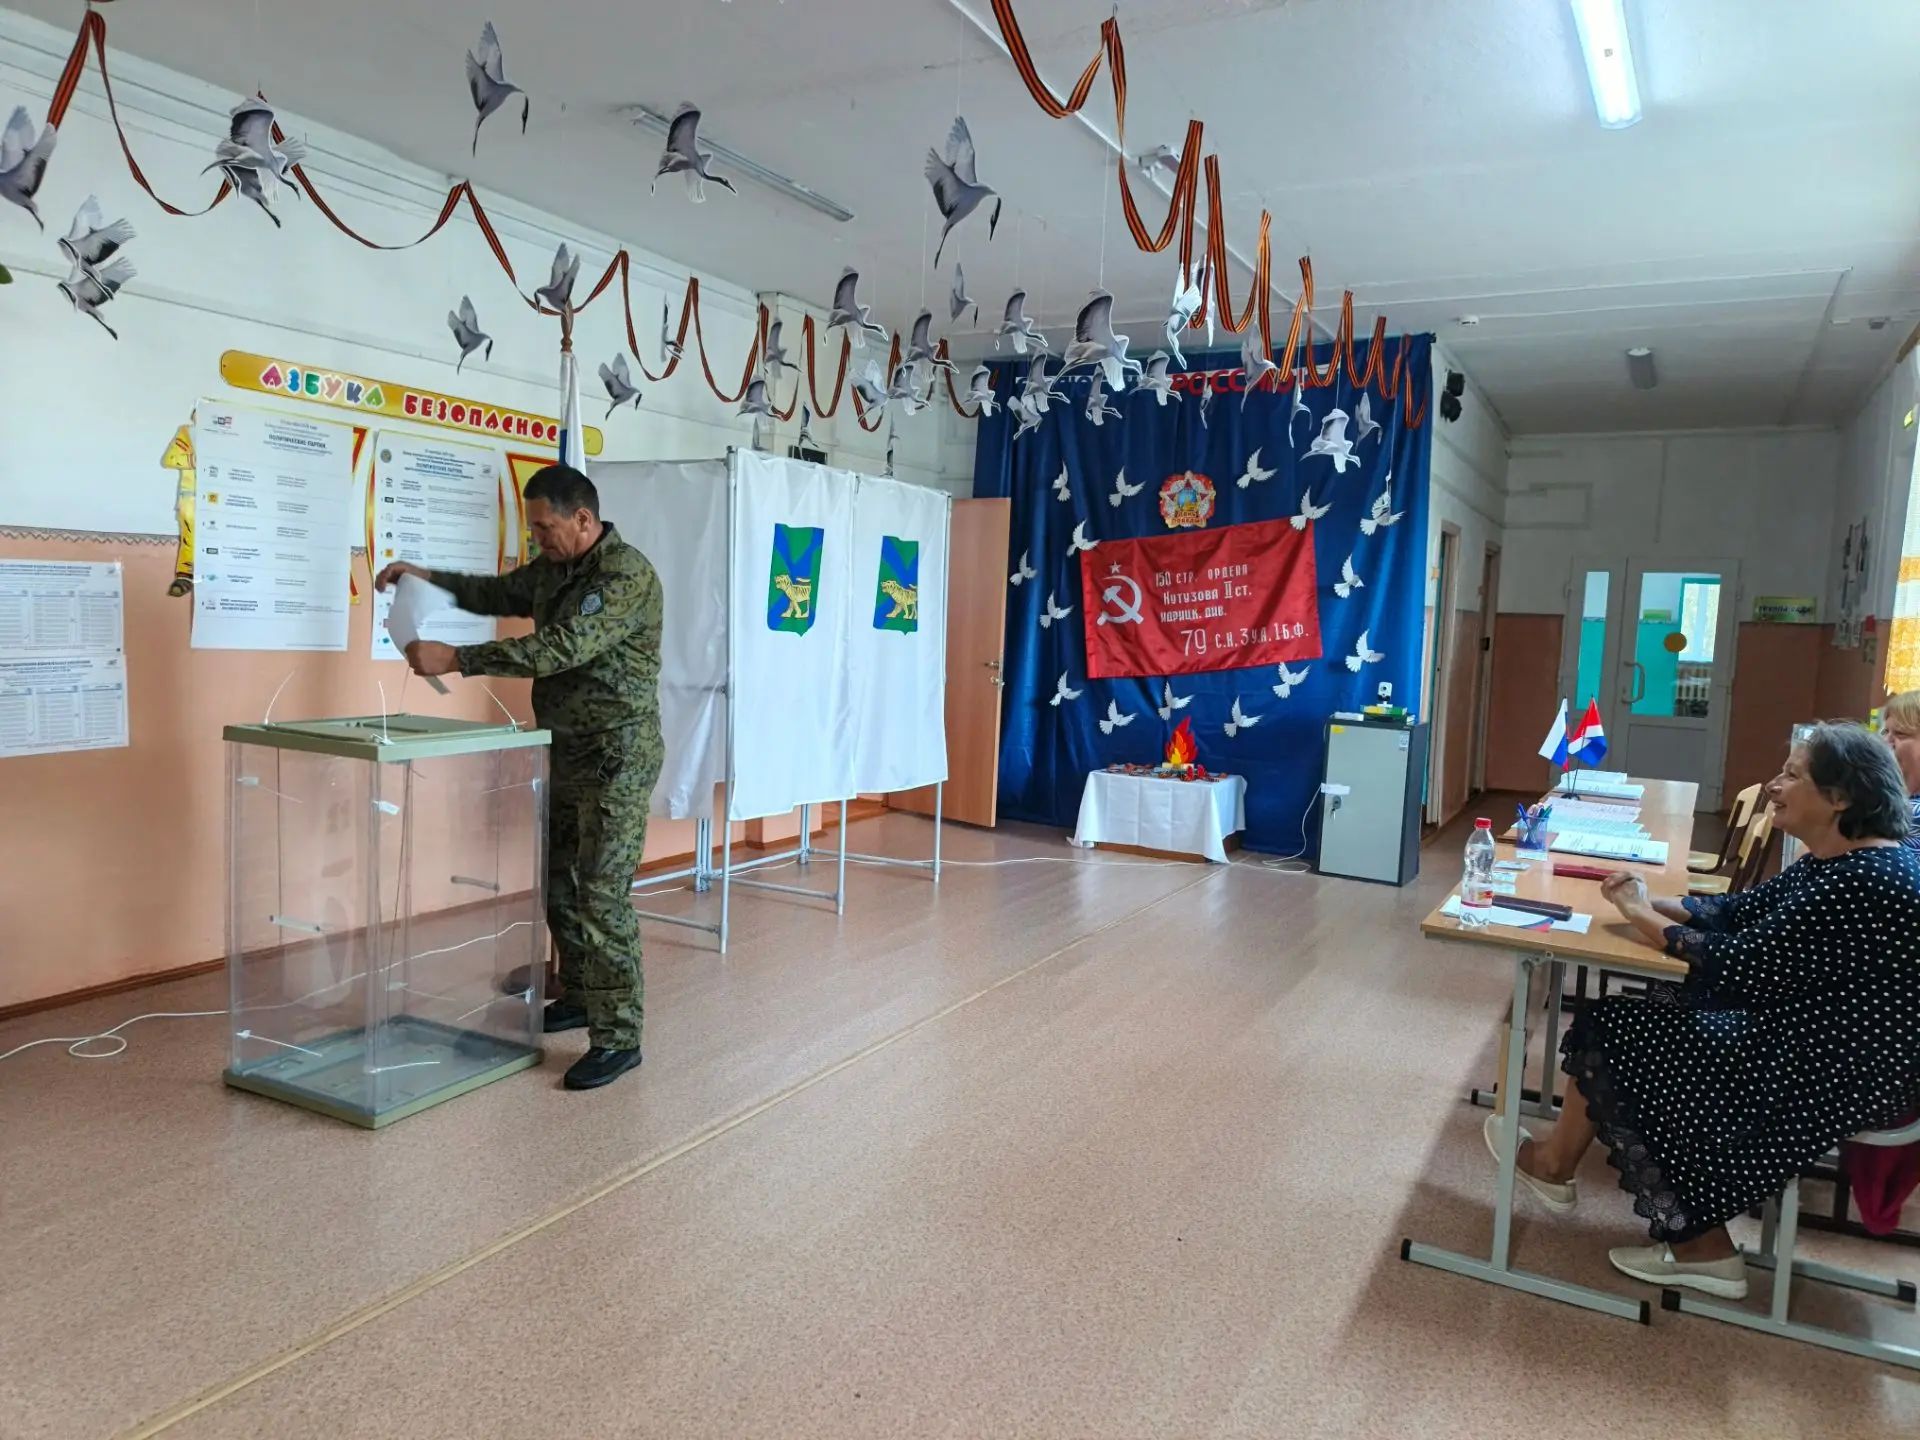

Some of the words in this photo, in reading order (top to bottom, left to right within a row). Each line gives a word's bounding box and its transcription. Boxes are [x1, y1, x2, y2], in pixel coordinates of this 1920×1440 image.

[259, 363, 385, 408] АЗБУКА
[403, 391, 558, 441] БЕЗОПАСНОС
[1155, 571, 1172, 588] 150
[1180, 628, 1208, 657] 79
